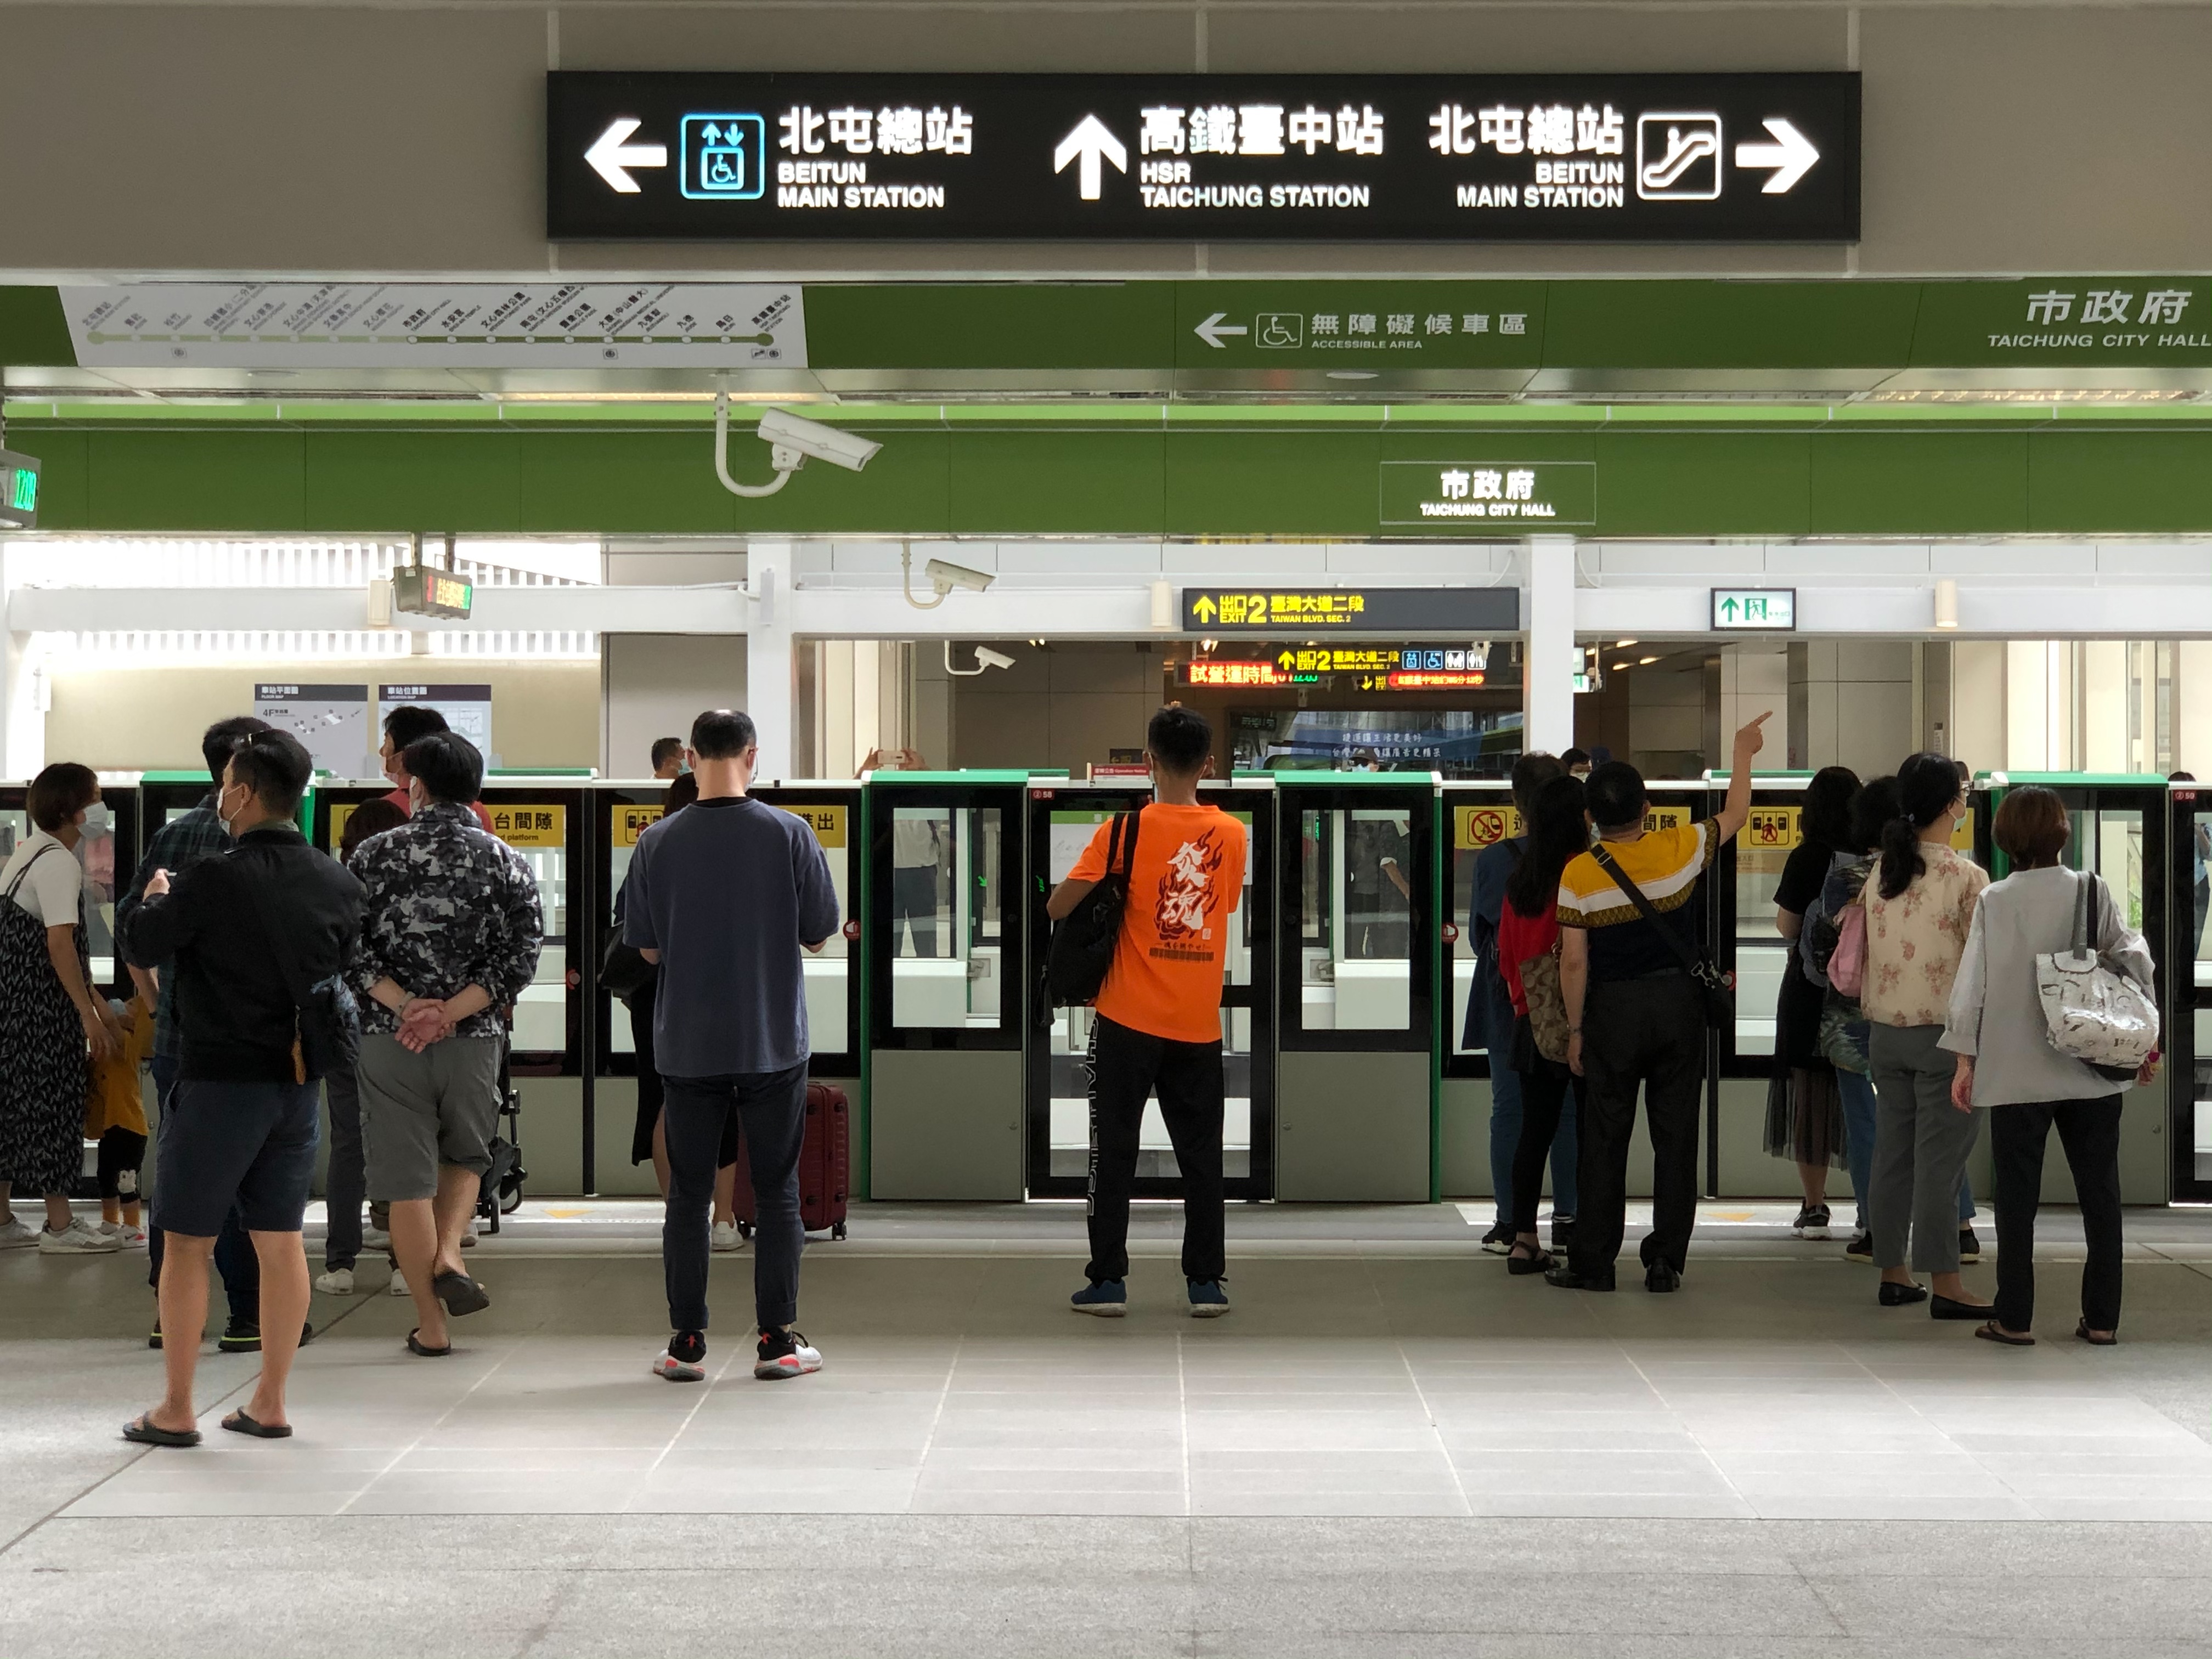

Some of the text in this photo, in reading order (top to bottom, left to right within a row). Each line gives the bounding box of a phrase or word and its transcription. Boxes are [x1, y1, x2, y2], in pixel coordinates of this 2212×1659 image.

[777, 105, 973, 155] 北屯總站
[1141, 105, 1384, 155] 高鐵臺中站
[1429, 104, 1624, 155] 北屯總站
[777, 162, 866, 184] BEITUN
[1141, 161, 1192, 183] HSR
[1536, 161, 1624, 184] BEITUN
[777, 187, 945, 208] MAIN STATION
[1140, 185, 1369, 207] TAICHUNG STATION
[1457, 186, 1624, 208] MAIN STATION
[2026, 289, 2192, 325] 市政府
[1311, 314, 1527, 335] 無障礙候車區
[1312, 340, 1423, 349] ACCESSIBLE AREA
[1988, 334, 2212, 347] TAICHUNG CITY HALL
[1440, 469, 1535, 500] 市政府
[1420, 503, 1555, 516] TAICHUNG CITY HALL
[1220, 596, 1364, 623] 出口 2 臺灣大道二段
[1220, 614, 1245, 623] EXIT
[1297, 651, 1316, 663] 出口
[1317, 651, 1331, 670] 2
[494, 812, 553, 830] 台間隙
[507, 833, 539, 843] platform
